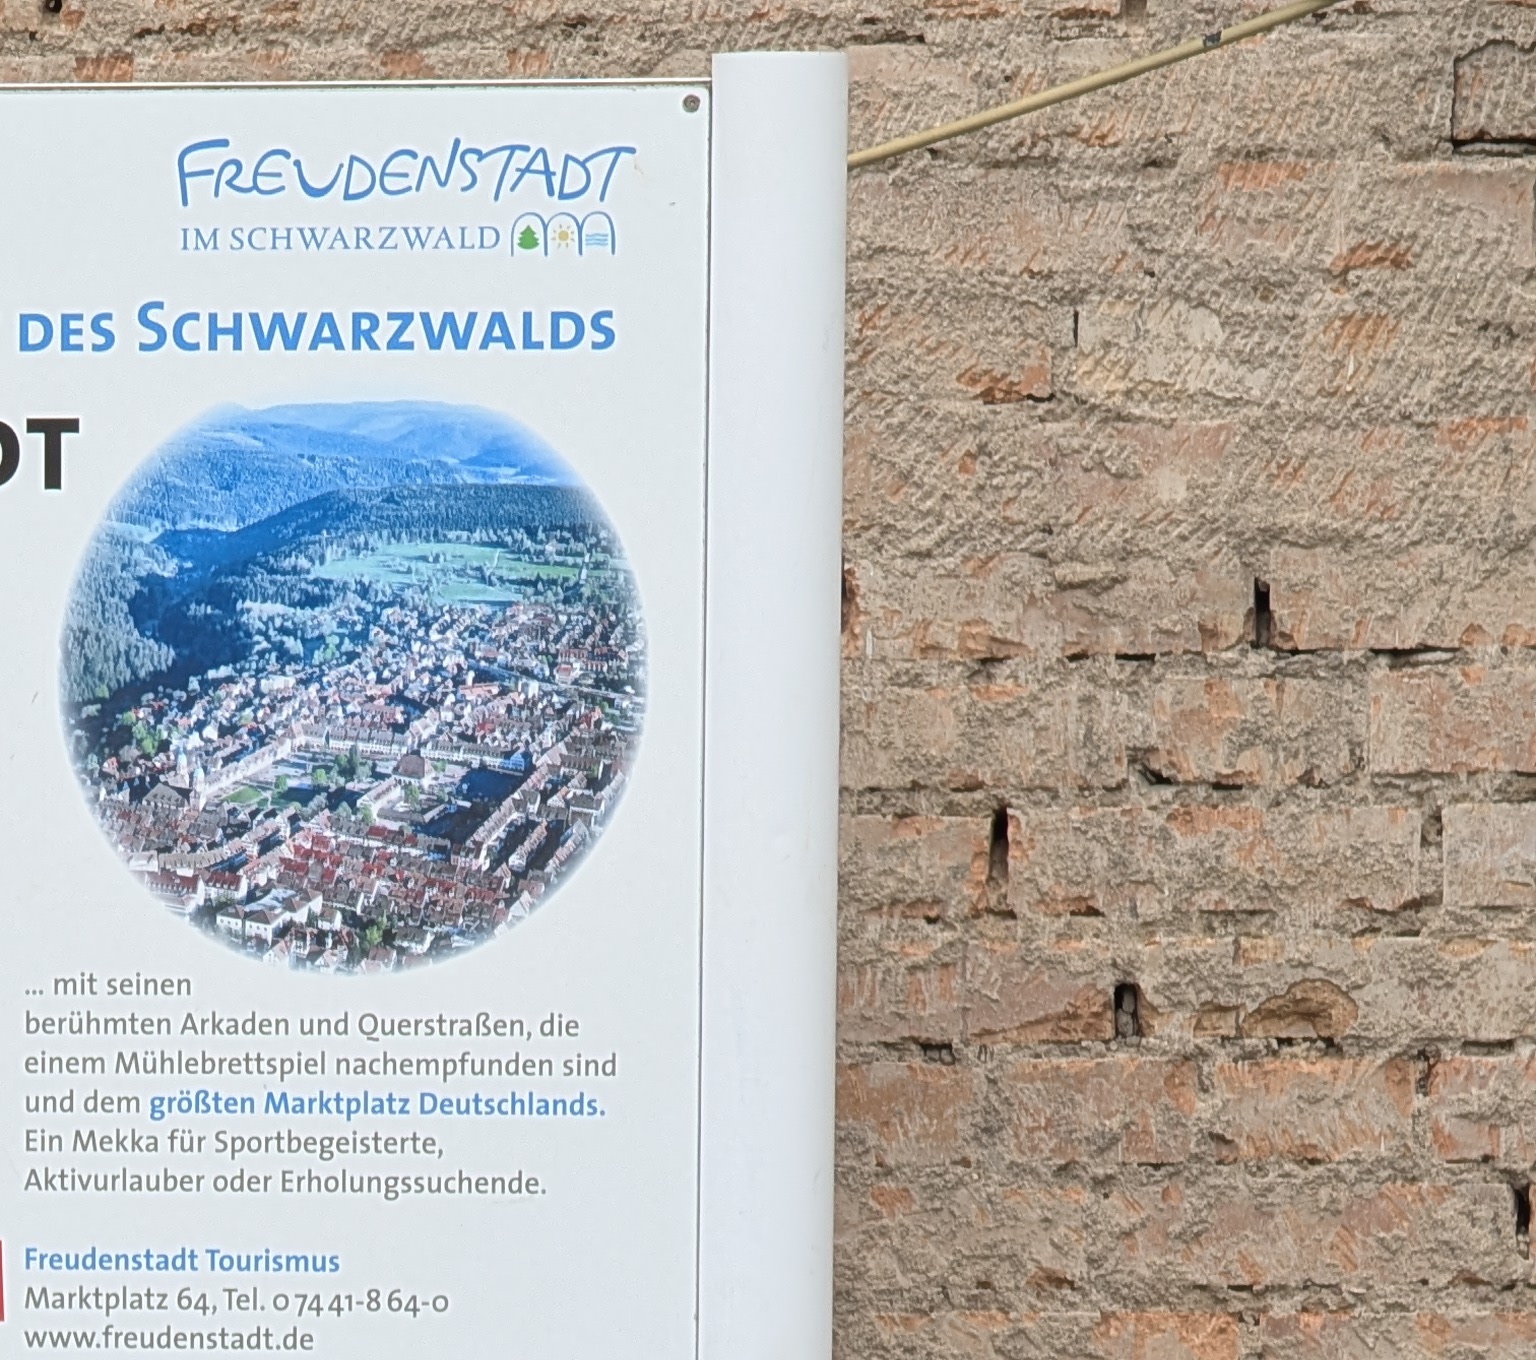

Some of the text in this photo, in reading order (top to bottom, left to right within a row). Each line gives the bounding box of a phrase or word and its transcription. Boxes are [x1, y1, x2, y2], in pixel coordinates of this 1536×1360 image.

[176, 137, 637, 207] FREUDENSTADT
[182, 227, 500, 250] IM SCHWARZWALD
[20, 313, 115, 352] DES
[55, 972, 97, 995] mit
[107, 972, 191, 995] seinen
[26, 1010, 579, 1041] berühmten Arkaden und Querstraßen, die
[25, 1050, 616, 1083] einem Mühlebrettspiel nachempfunden sind
[26, 1089, 605, 1121] und dem größten Marktplatz Deutschlands.
[26, 1128, 443, 1161] Ein Mekka für Sportbegeisterte,
[24, 1167, 546, 1201] Aktivurlauber oder Erholungssuchende.
[26, 1247, 339, 1272] Freudenstadt Tourismus
[25, 1285, 168, 1317] Marktplatz
[178, 1287, 217, 1316] 64,
[223, 1287, 265, 1311] Tel.
[24, 1325, 313, 1350] www.freudenstadt.de
